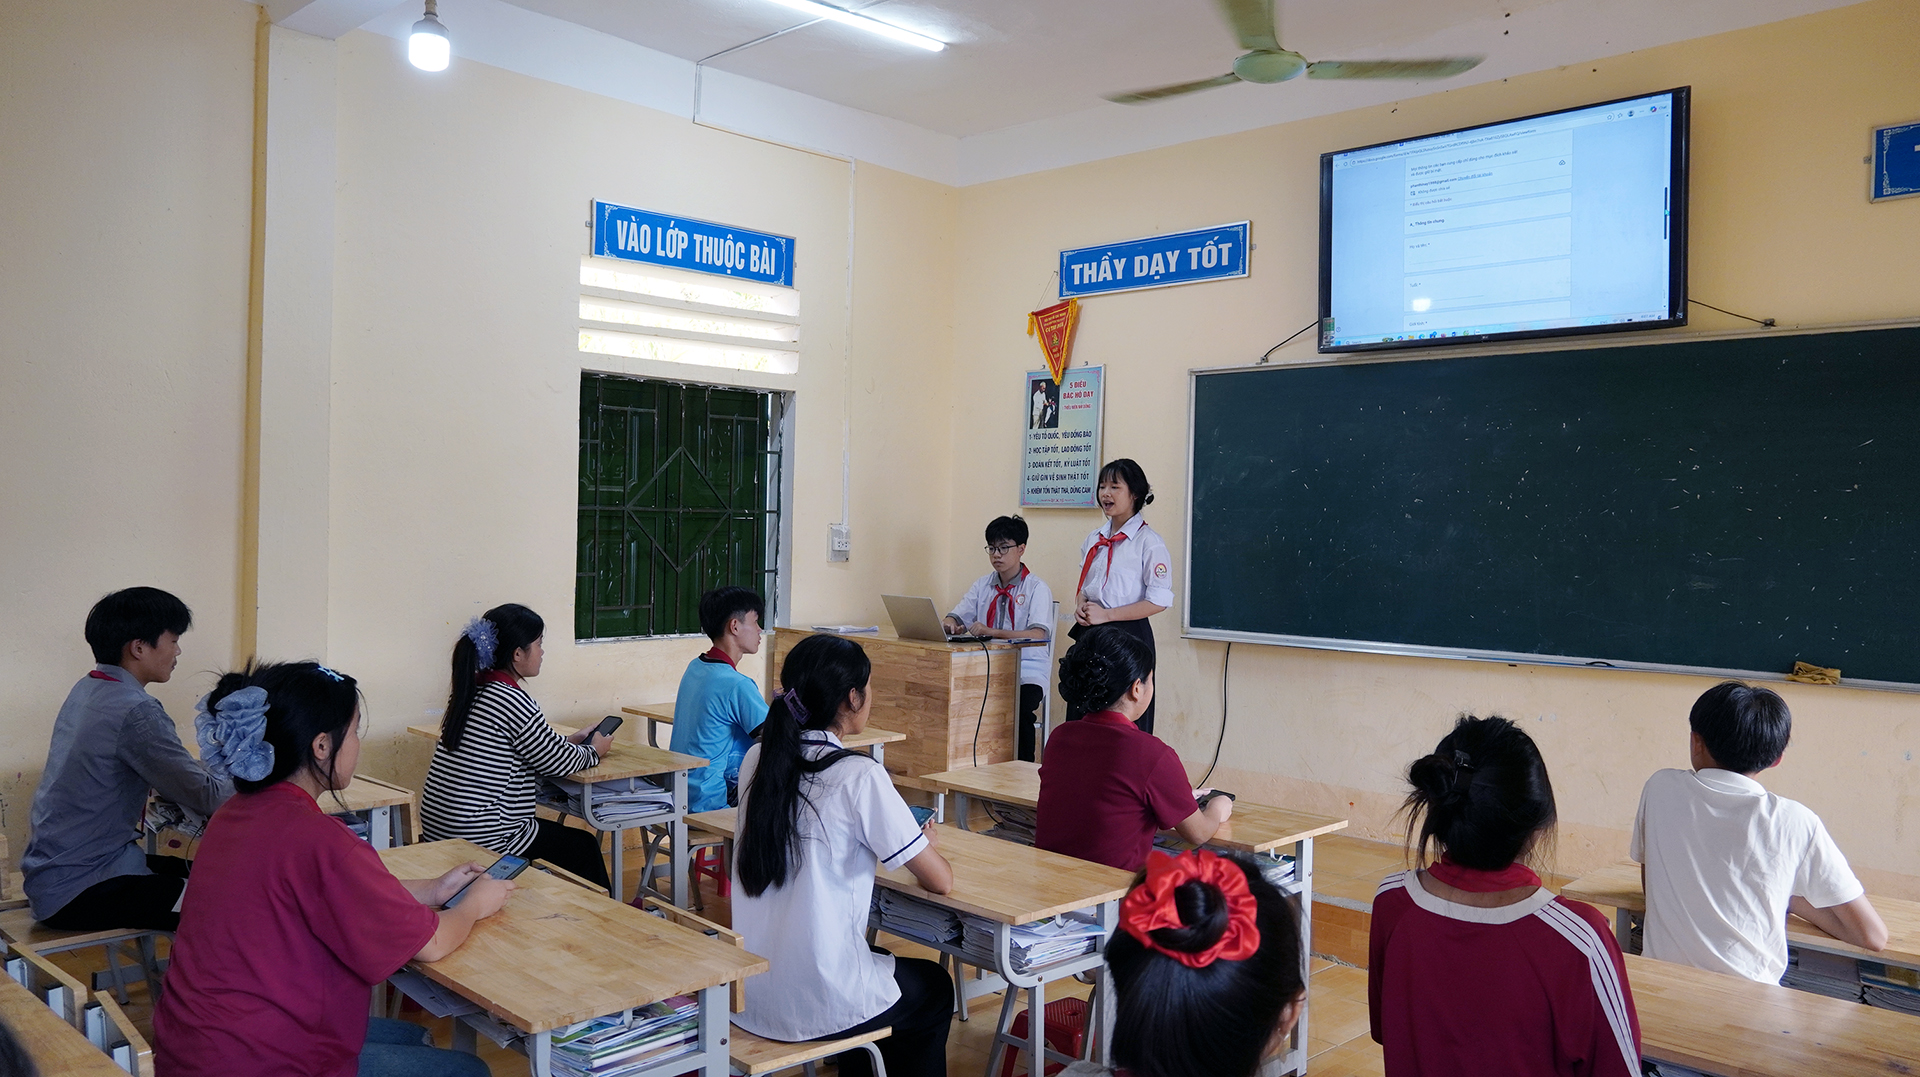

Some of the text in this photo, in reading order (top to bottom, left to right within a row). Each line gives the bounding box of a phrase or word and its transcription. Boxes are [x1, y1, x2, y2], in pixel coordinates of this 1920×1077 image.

[617, 216, 775, 275] VÀO LỚP THUỘC BÀI
[1071, 236, 1233, 285] THẦY DẠY TỐT
[1083, 391, 1094, 399] DẠY
[1033, 432, 1041, 440] YÊU
[1061, 430, 1070, 439] YÊU
[1042, 444, 1050, 455] TẬP
[1071, 444, 1082, 454] ĐỘNG
[1083, 442, 1092, 452] TỐT
[1071, 458, 1081, 469] LUẬT
[1083, 457, 1091, 467] TỐT
[1068, 472, 1079, 482] THẬT
[1080, 470, 1089, 480] TỐT
